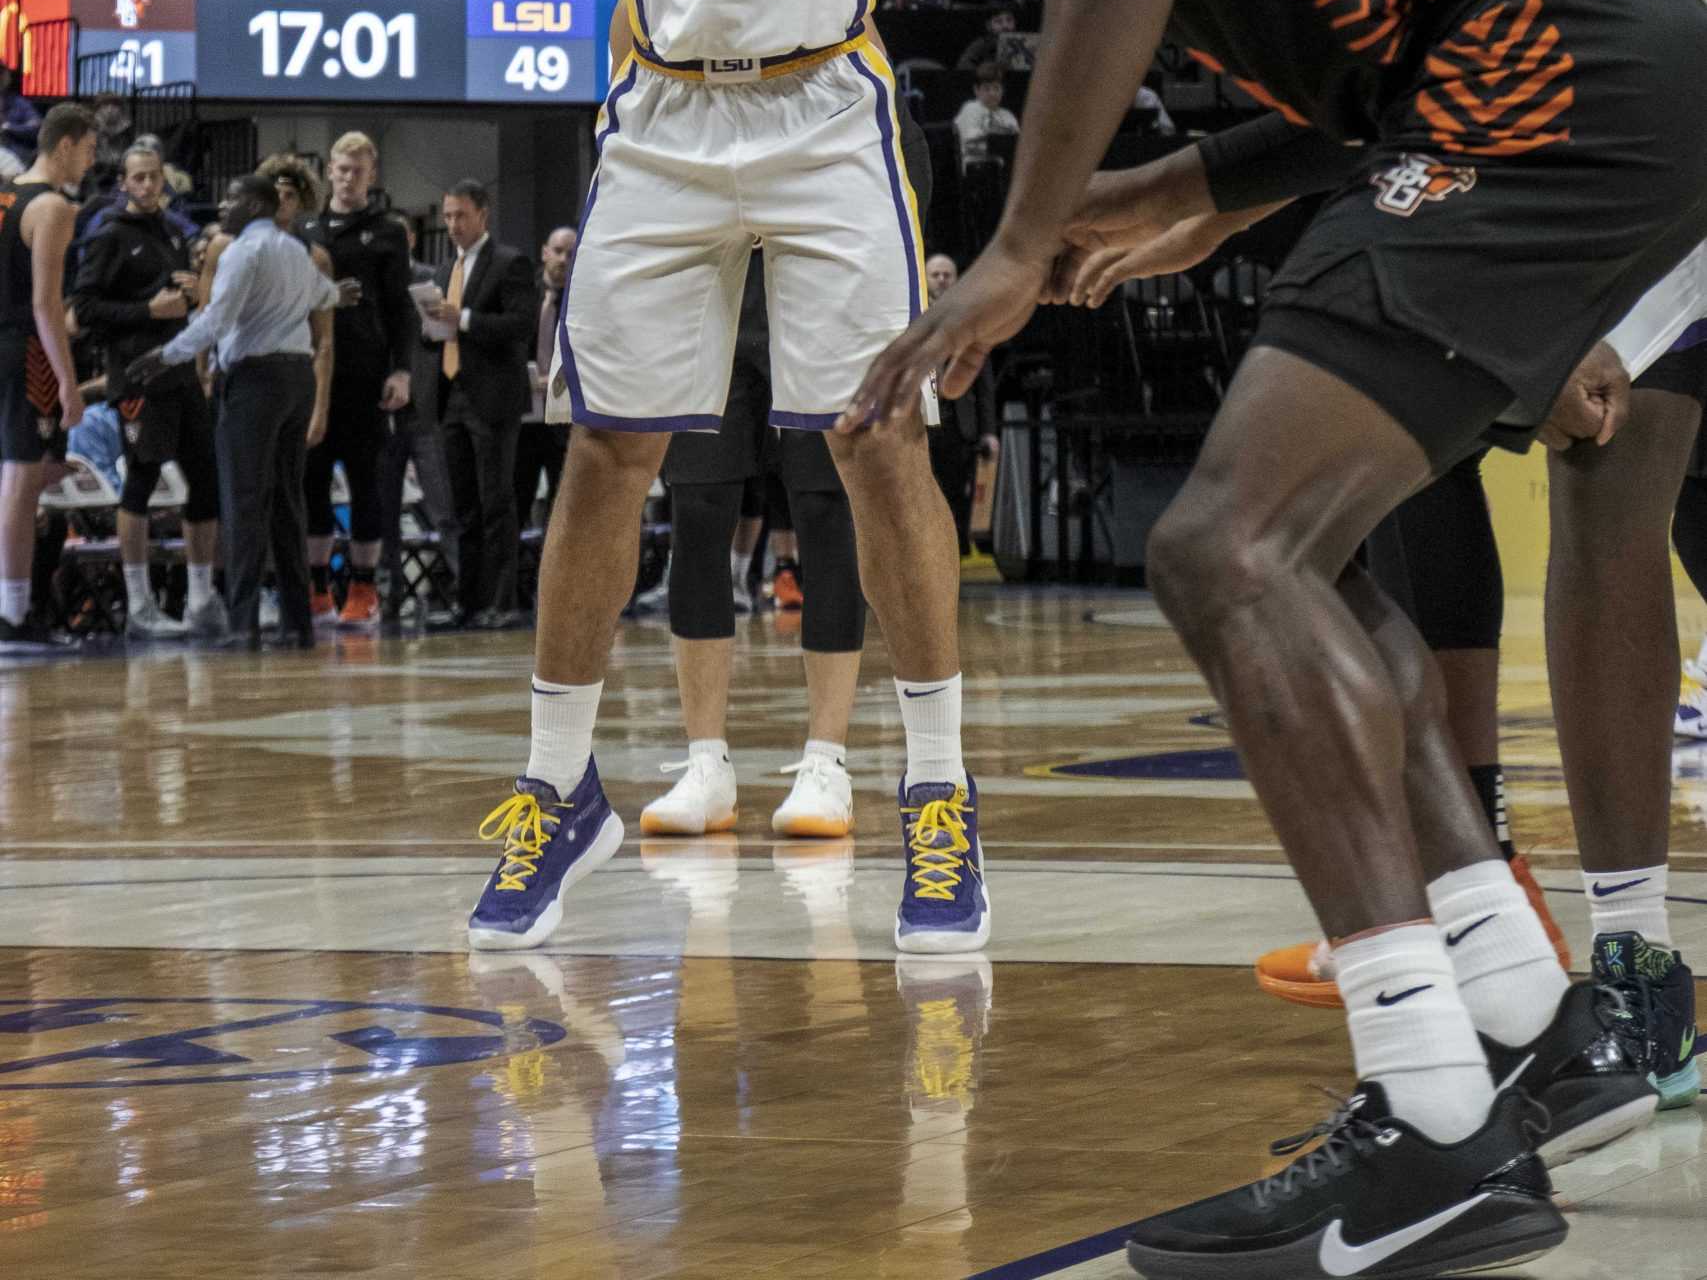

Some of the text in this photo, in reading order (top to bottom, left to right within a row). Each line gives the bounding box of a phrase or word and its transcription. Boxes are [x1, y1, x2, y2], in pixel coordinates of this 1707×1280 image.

[492, 1, 571, 32] LSU
[249, 10, 416, 79] 17:01
[505, 46, 570, 91] 49
[711, 58, 753, 73] LSU
